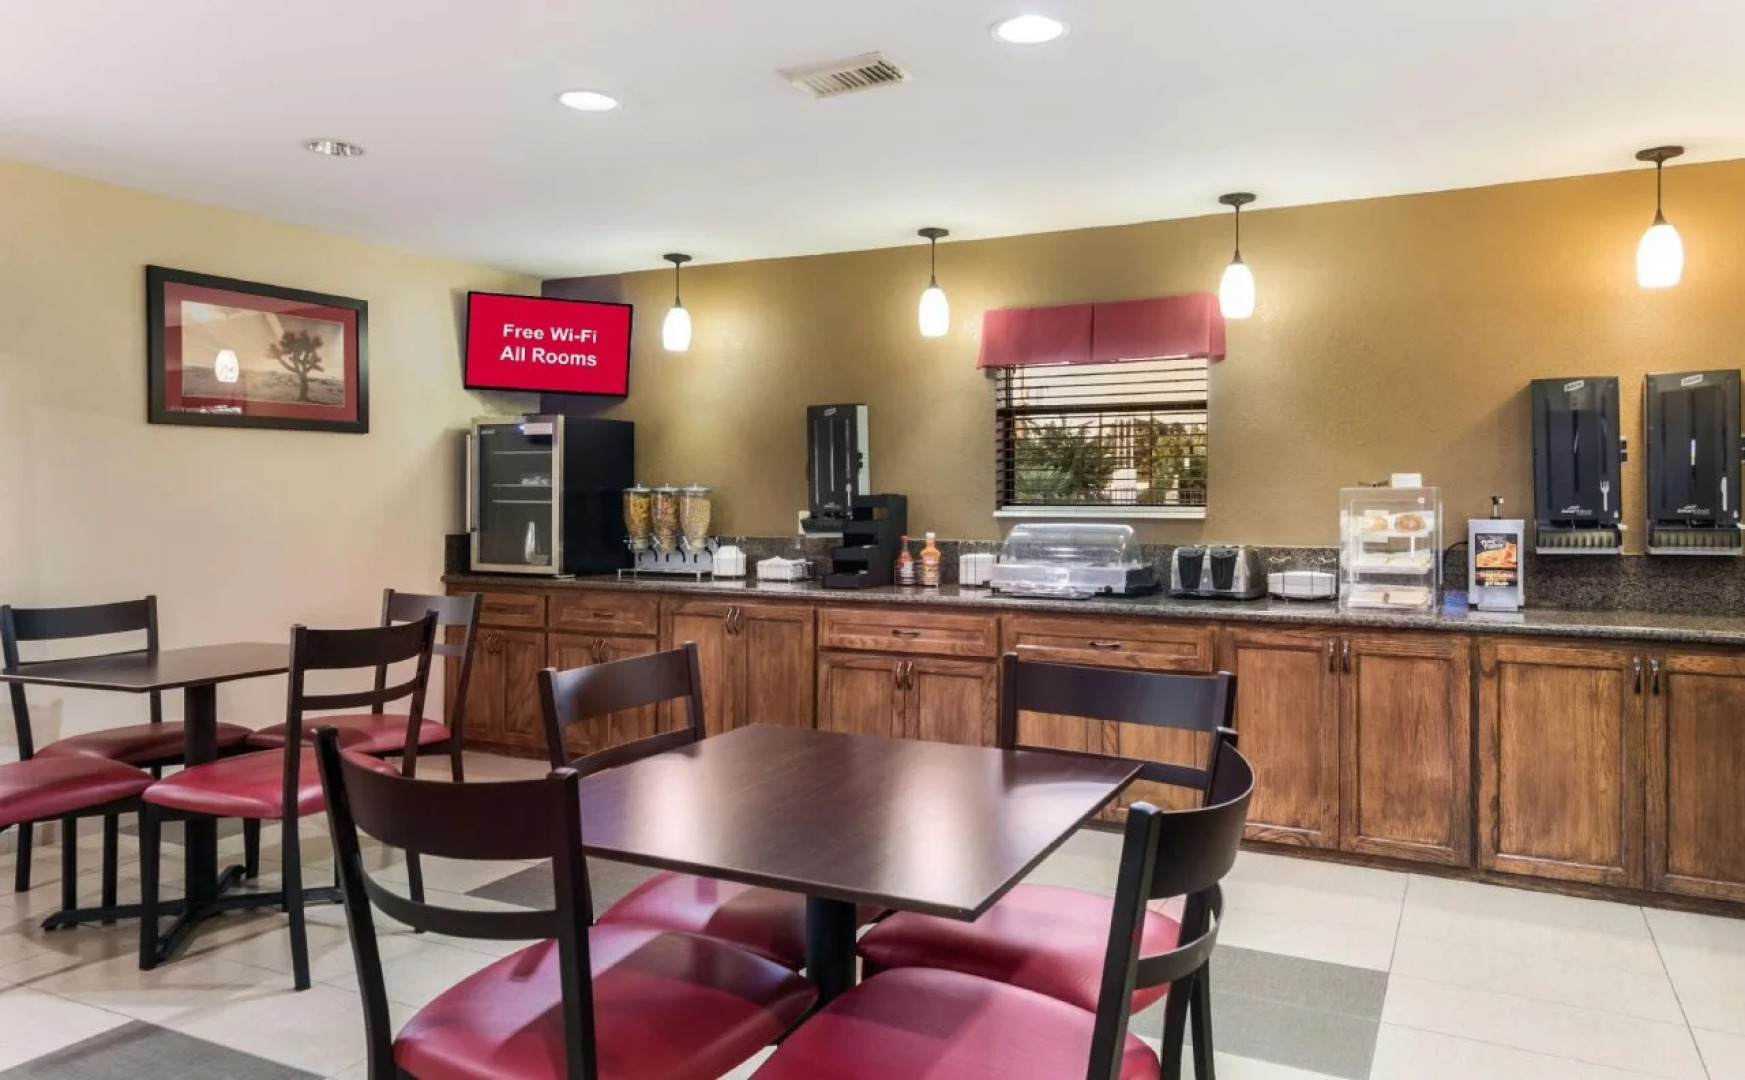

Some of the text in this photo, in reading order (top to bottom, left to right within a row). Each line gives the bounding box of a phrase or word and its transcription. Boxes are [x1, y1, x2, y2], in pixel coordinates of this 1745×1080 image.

[503, 323, 597, 343] Free Wi-Fi
[500, 346, 597, 366] All Rooms
